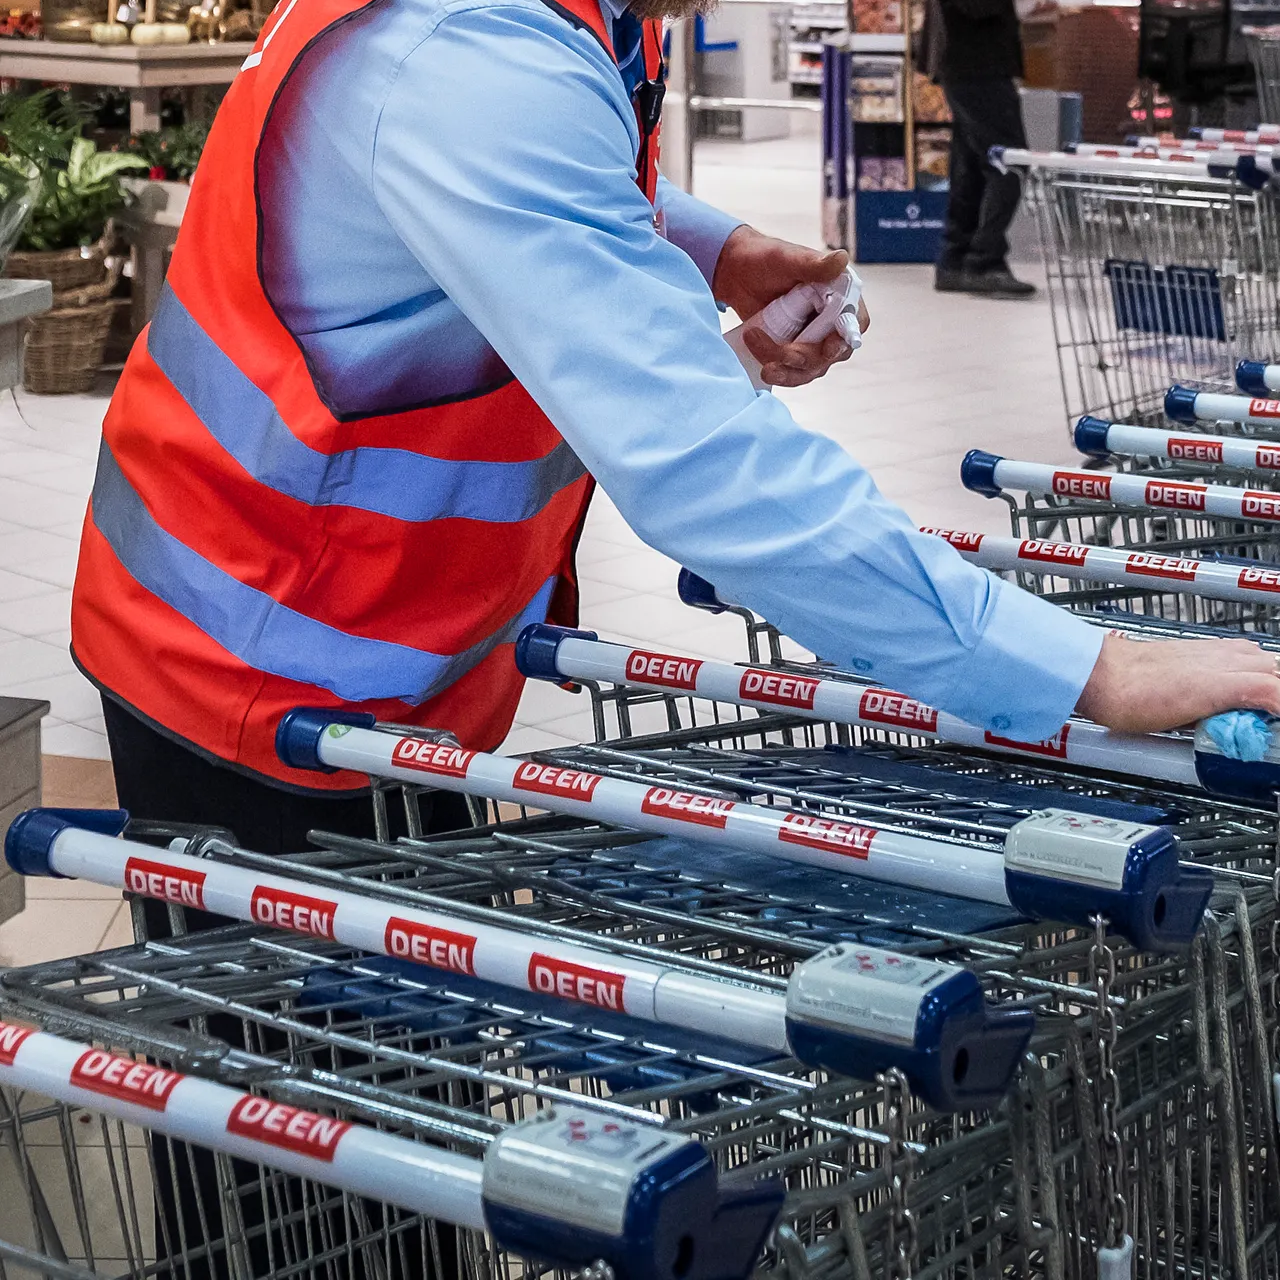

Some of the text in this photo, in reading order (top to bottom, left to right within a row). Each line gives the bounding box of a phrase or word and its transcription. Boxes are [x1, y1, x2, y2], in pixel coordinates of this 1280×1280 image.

[1170, 445, 1221, 462] DEEN
[1056, 478, 1109, 498] DEEN
[1148, 488, 1205, 507] DEEN
[1023, 539, 1087, 560] DEEN
[1130, 555, 1198, 575] DEEN
[630, 655, 936, 724] DEEN DEEN DEEN
[398, 739, 874, 849] DEEN DEEN DEEN DEEN
[127, 869, 619, 1010] DEEN DEEN DEEN DEEN
[86, 1051, 177, 1098] DEEN
[238, 1095, 342, 1147] DEEN
